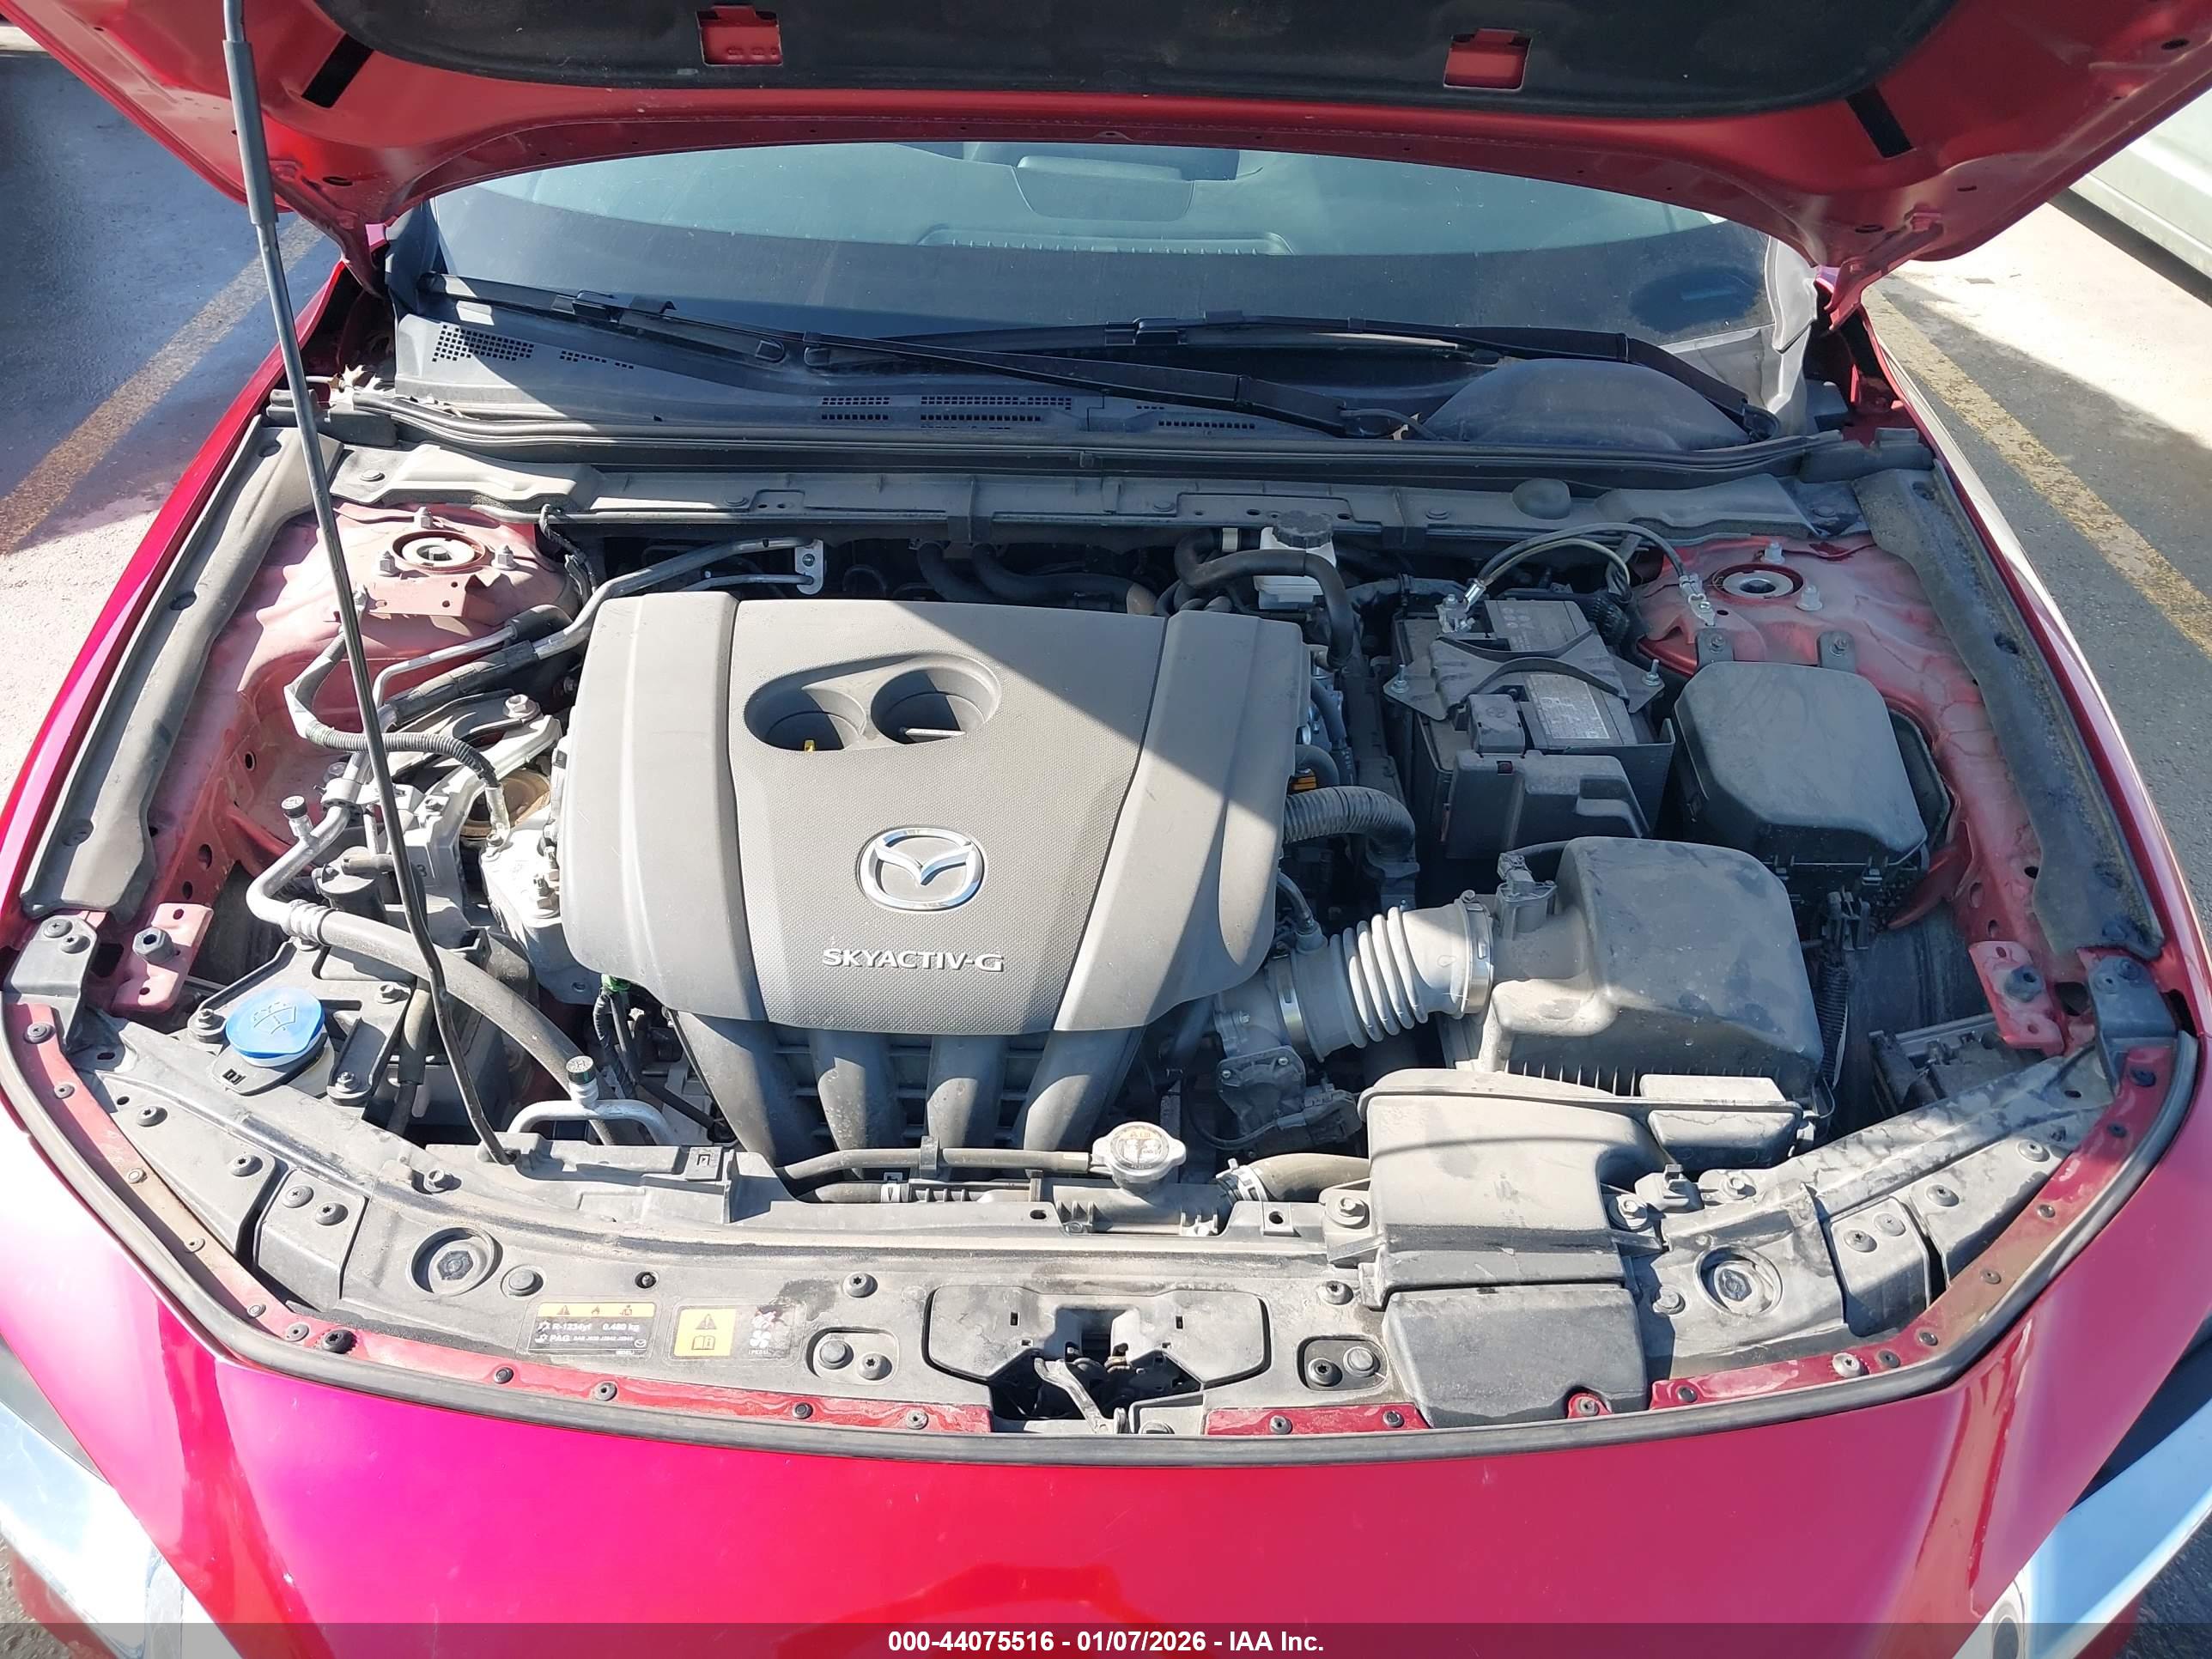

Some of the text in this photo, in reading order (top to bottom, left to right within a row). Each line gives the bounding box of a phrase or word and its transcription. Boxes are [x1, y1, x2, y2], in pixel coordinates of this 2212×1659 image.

[822, 948, 1005, 972] SKYACTIV-G
[551, 1322, 592, 1332] R-1234yf
[628, 1323, 640, 1332] kg
